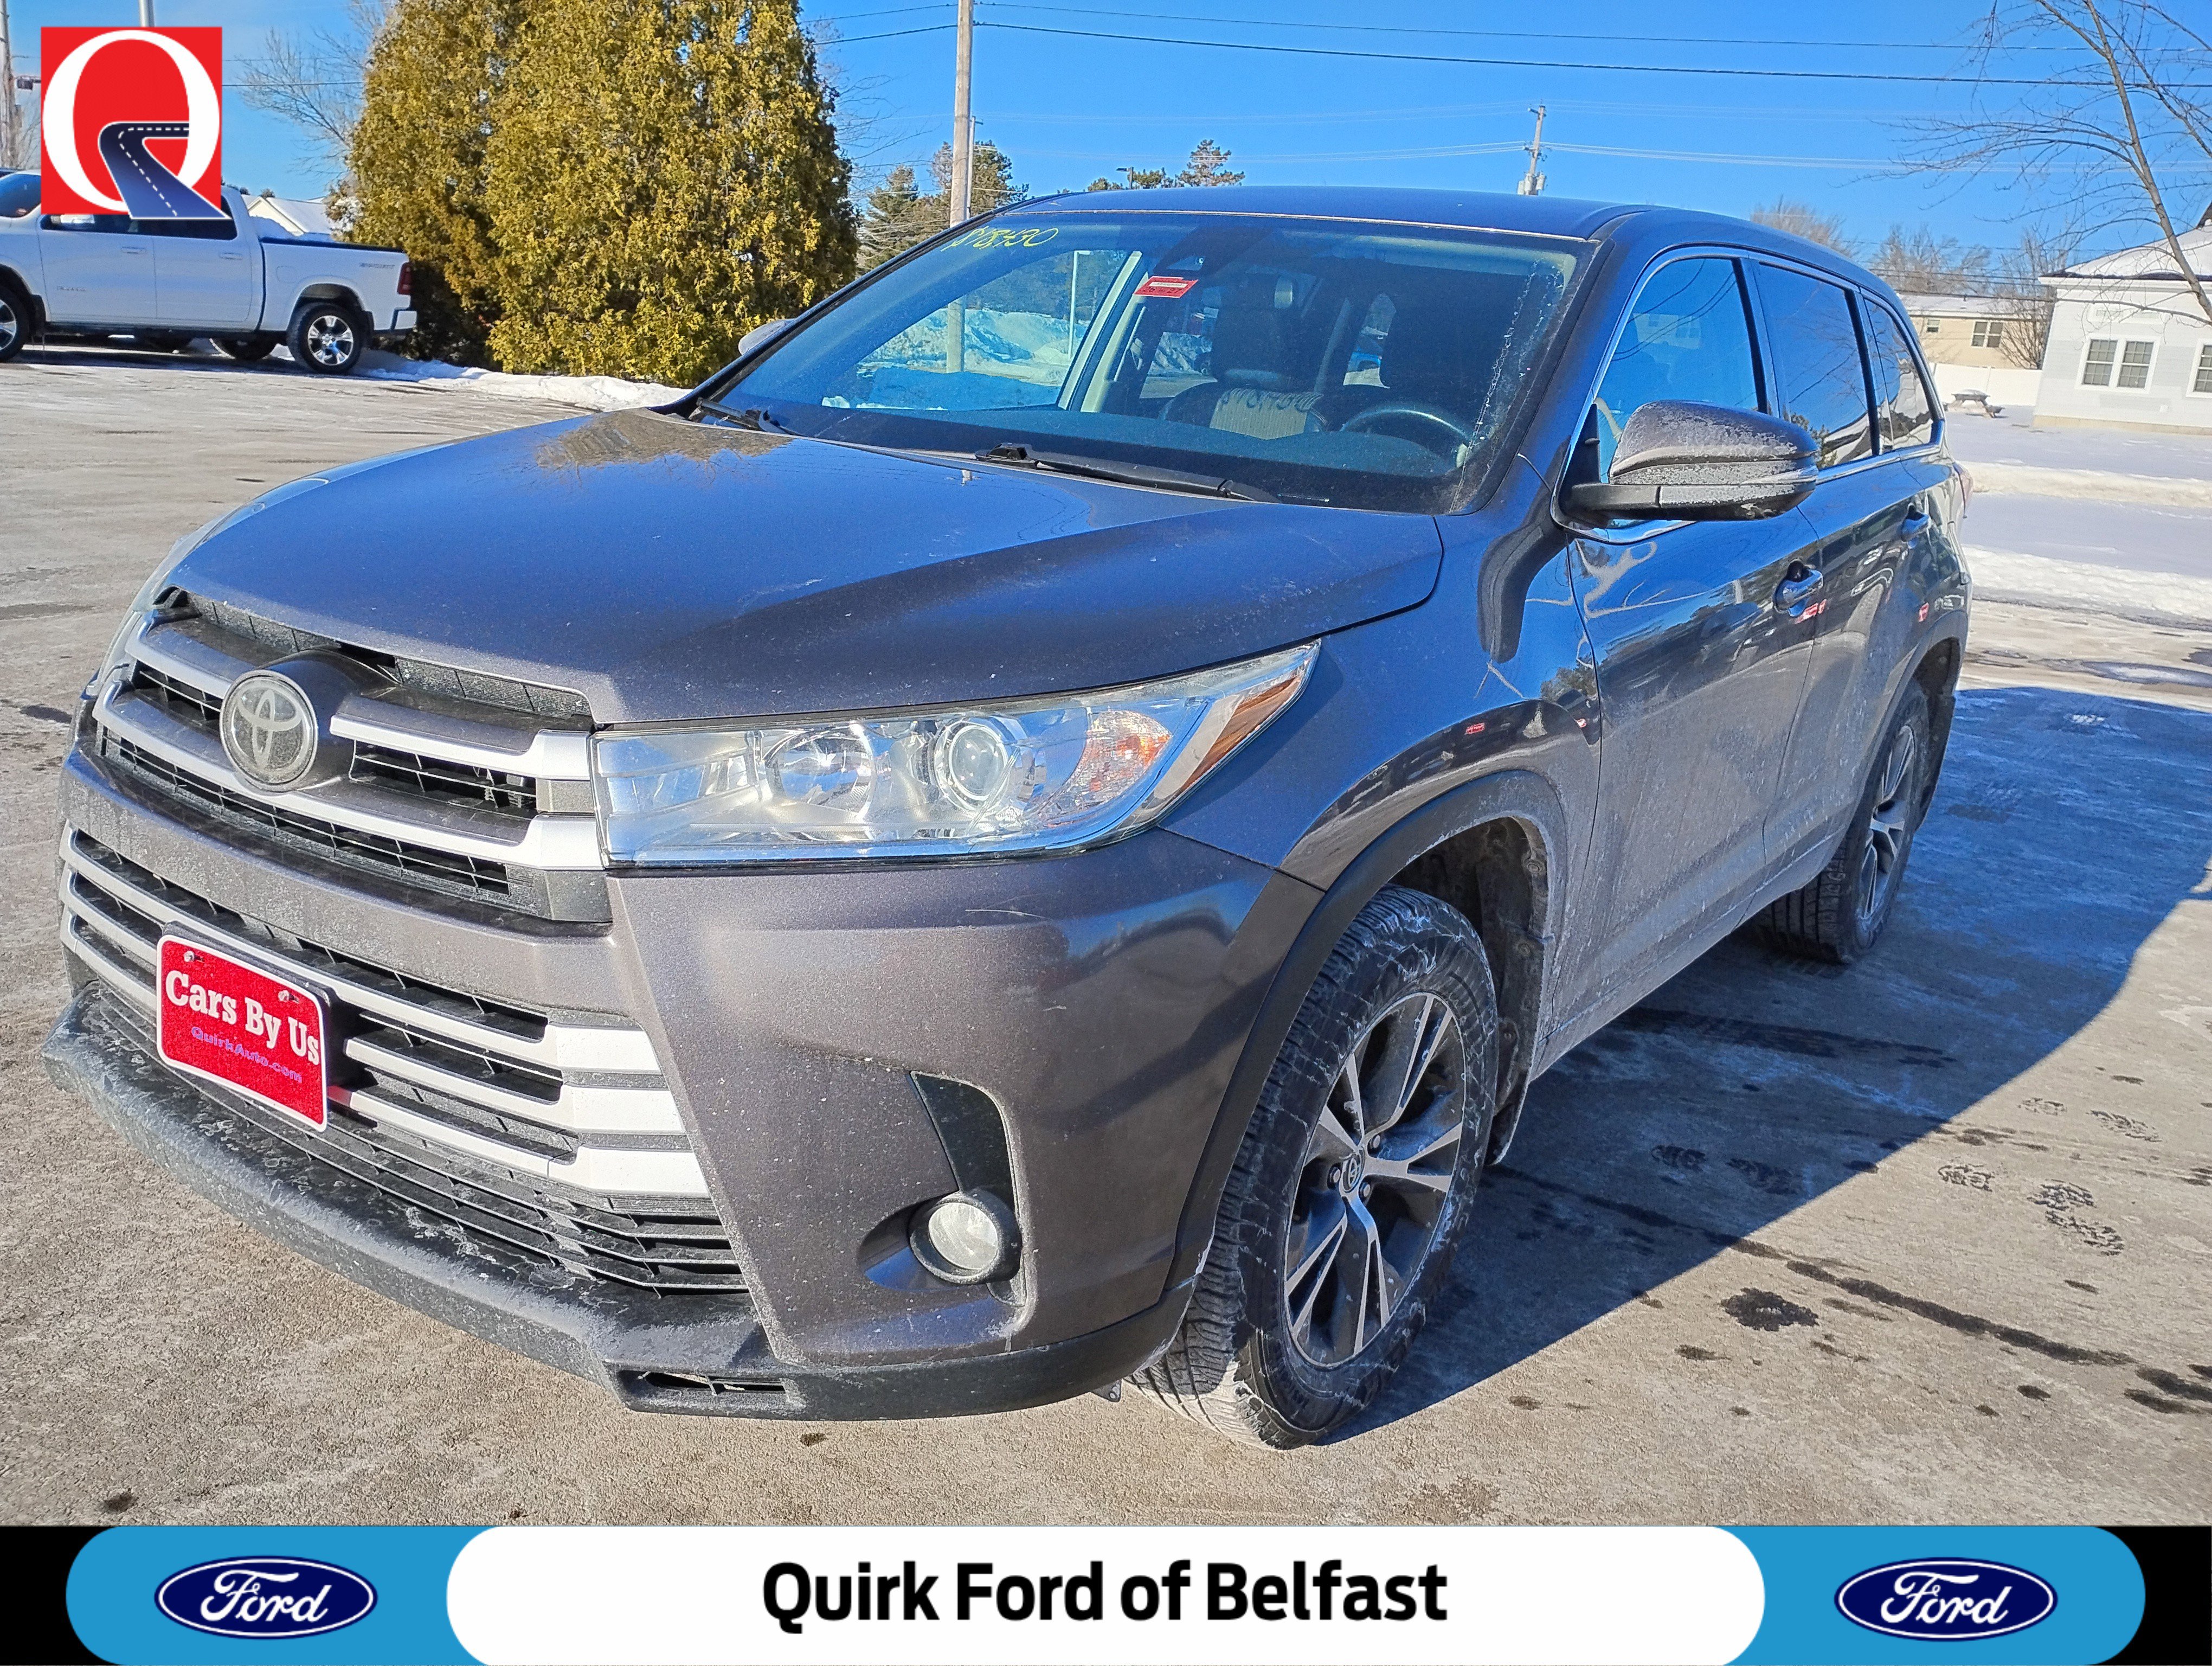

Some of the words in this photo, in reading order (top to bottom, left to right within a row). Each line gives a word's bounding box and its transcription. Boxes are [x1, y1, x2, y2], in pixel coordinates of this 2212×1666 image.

[165, 970, 237, 1026] Cars
[244, 996, 282, 1049] By
[288, 1016, 319, 1066] Us
[191, 1026, 303, 1084] QuirkAuto.com
